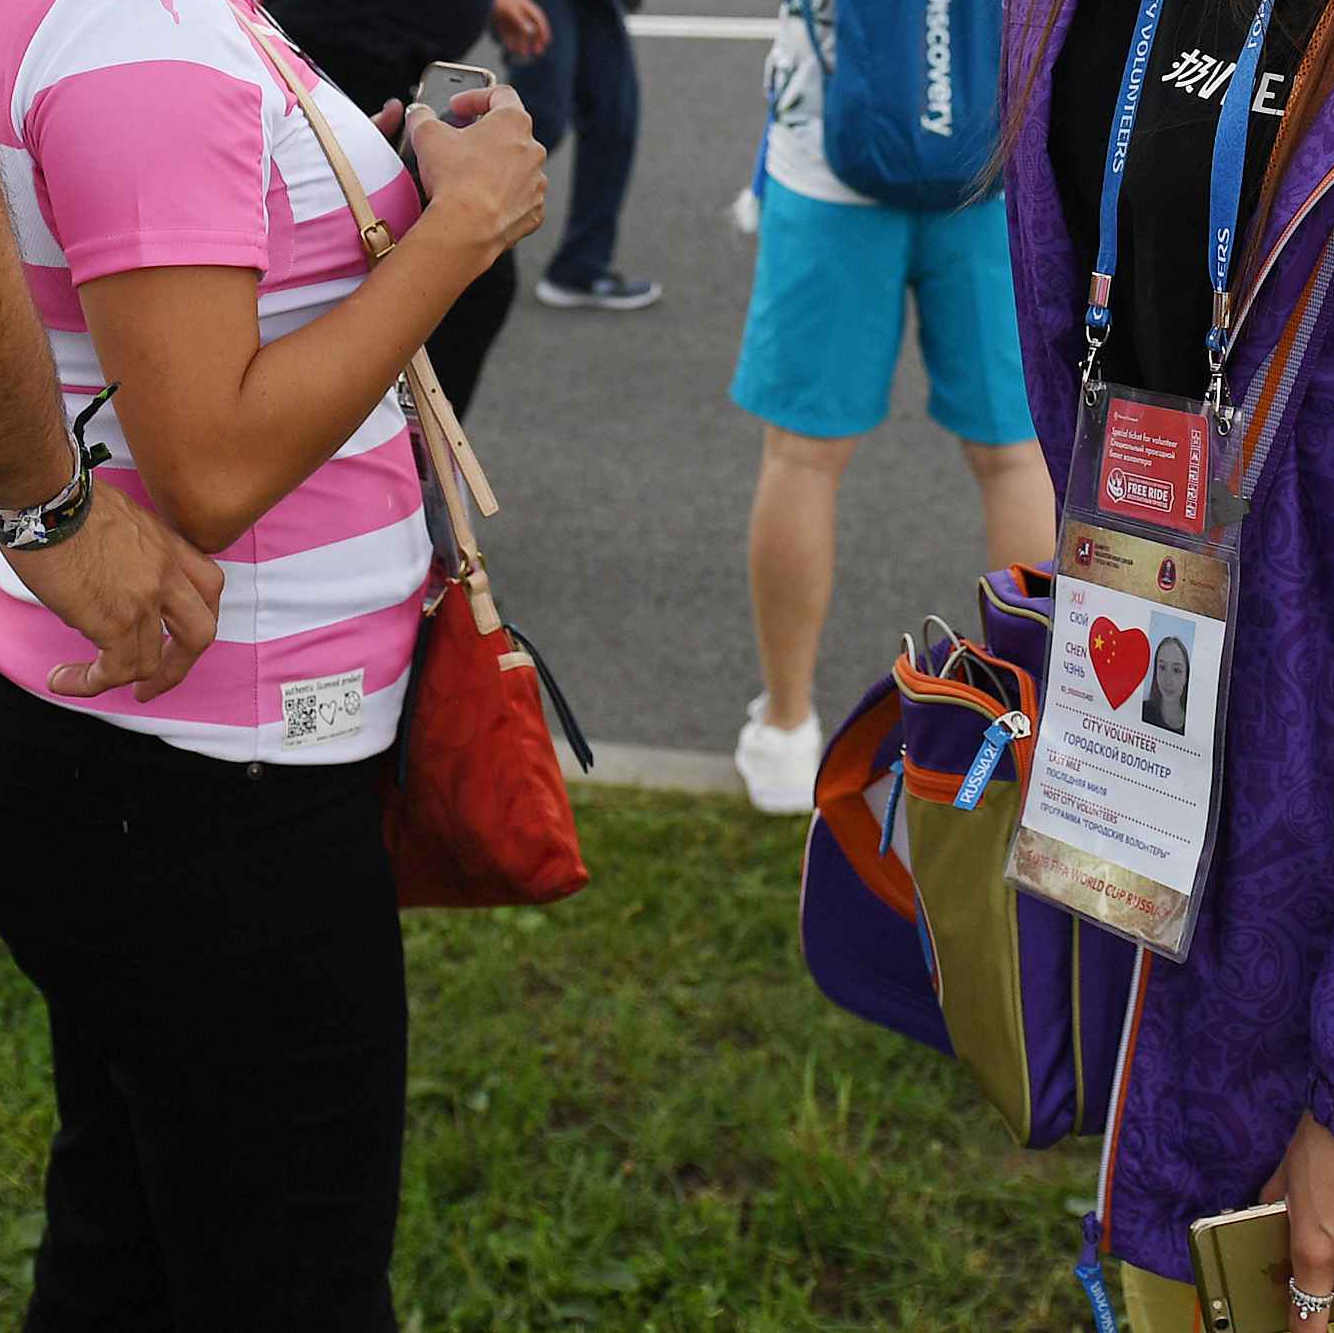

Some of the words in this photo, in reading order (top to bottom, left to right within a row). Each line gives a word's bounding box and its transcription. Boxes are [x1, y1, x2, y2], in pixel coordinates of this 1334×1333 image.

[1111, 22, 1155, 175] VOLUNTEERS
[1127, 481, 1148, 496] FREE
[1148, 487, 1169, 502] RIDE
[1066, 641, 1087, 658] CHEN
[1063, 661, 1086, 678] ЧЭНЬ
[1082, 717, 1103, 735] CITY
[1104, 725, 1157, 754] VOLUNTEER
[1063, 731, 1119, 761] ГОРОДСКОЙ
[1120, 752, 1172, 779] ВОЛОНТЕР
[1076, 800, 1118, 825] VOLUNTEERS
[1071, 868, 1105, 893] WORLD
[1105, 884, 1127, 902] CUP
